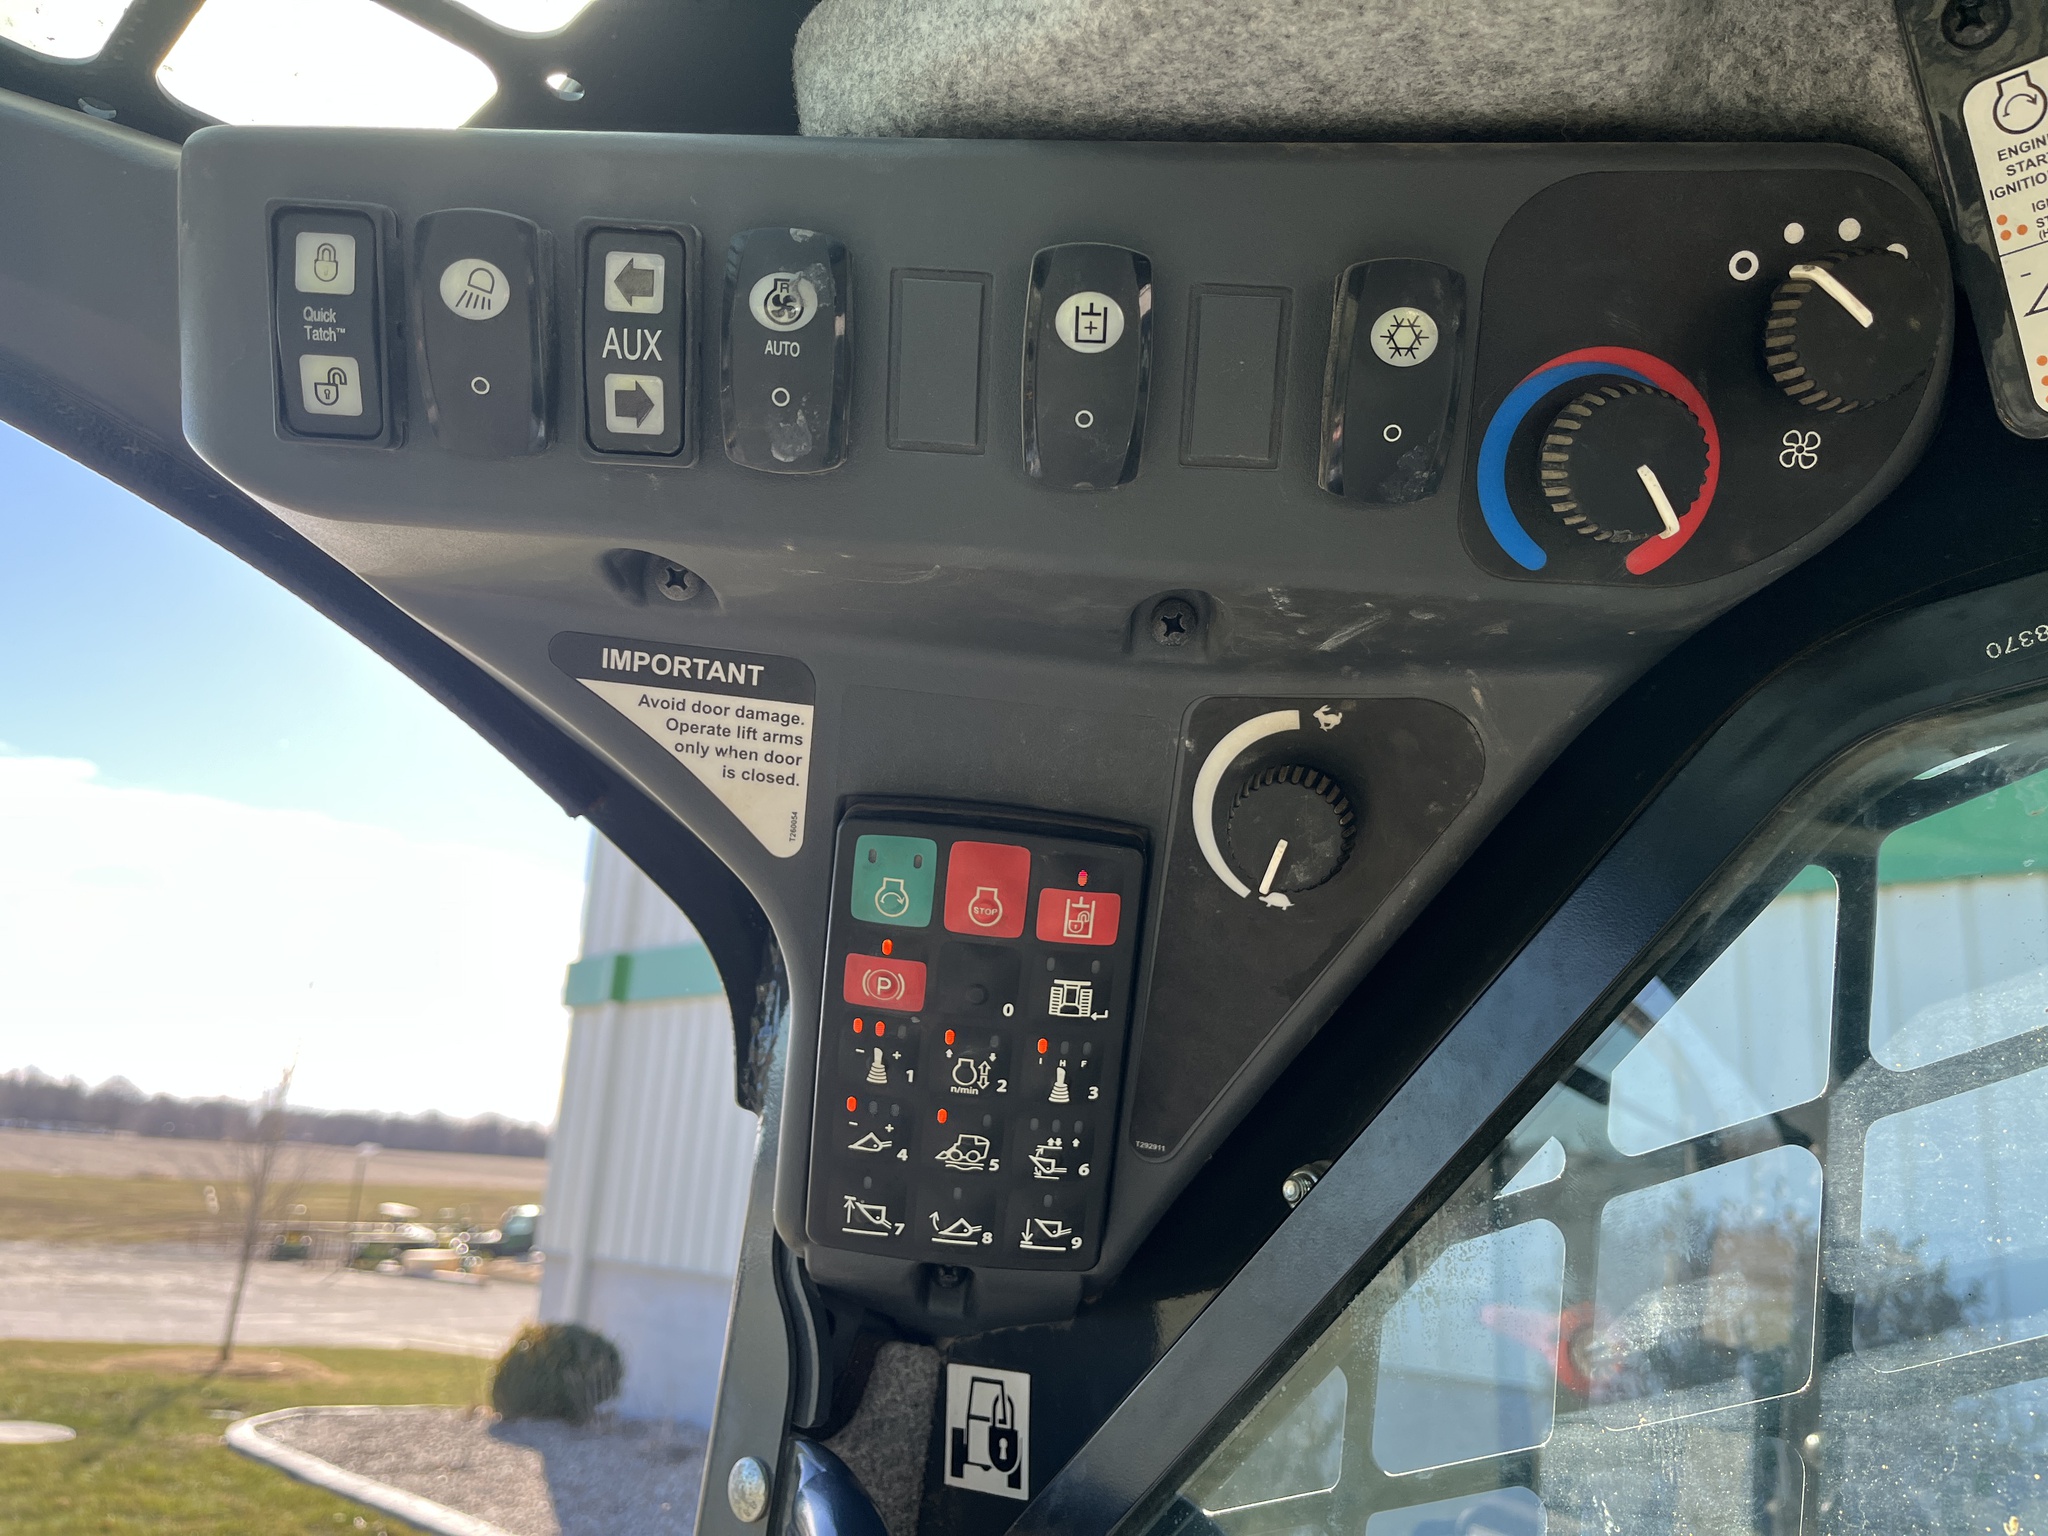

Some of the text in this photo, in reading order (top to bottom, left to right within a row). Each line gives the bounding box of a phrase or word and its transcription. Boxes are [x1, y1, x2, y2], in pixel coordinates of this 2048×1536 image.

[1997, 133, 2048, 162] ENGIN
[2006, 152, 2048, 176] STAR
[1989, 170, 2048, 201] IGNITIO
[303, 306, 337, 323] Quick
[602, 327, 663, 362] AUX
[764, 340, 800, 357] AUTO
[601, 647, 765, 686] IMPORTANT
[638, 694, 805, 727] Avoid door damage.
[666, 718, 804, 746] Operate lift arms
[674, 741, 803, 766] only when door
[722, 765, 801, 787] is closed.
[973, 906, 998, 916] STOP
[877, 976, 892, 996] P
[1002, 1003, 1015, 1017] 0
[1059, 1059, 1067, 1067] H
[1080, 1060, 1088, 1068] F
[906, 1069, 914, 1083] 1
[950, 1086, 979, 1095] n/min
[996, 1079, 1008, 1092] 2
[1088, 1086, 1099, 1100] 3
[896, 1148, 909, 1161] 4
[989, 1158, 1000, 1171] 5
[1078, 1163, 1090, 1176] 6
[894, 1223, 905, 1235] 7
[981, 1231, 993, 1244] 8
[1071, 1236, 1083, 1250] 9
